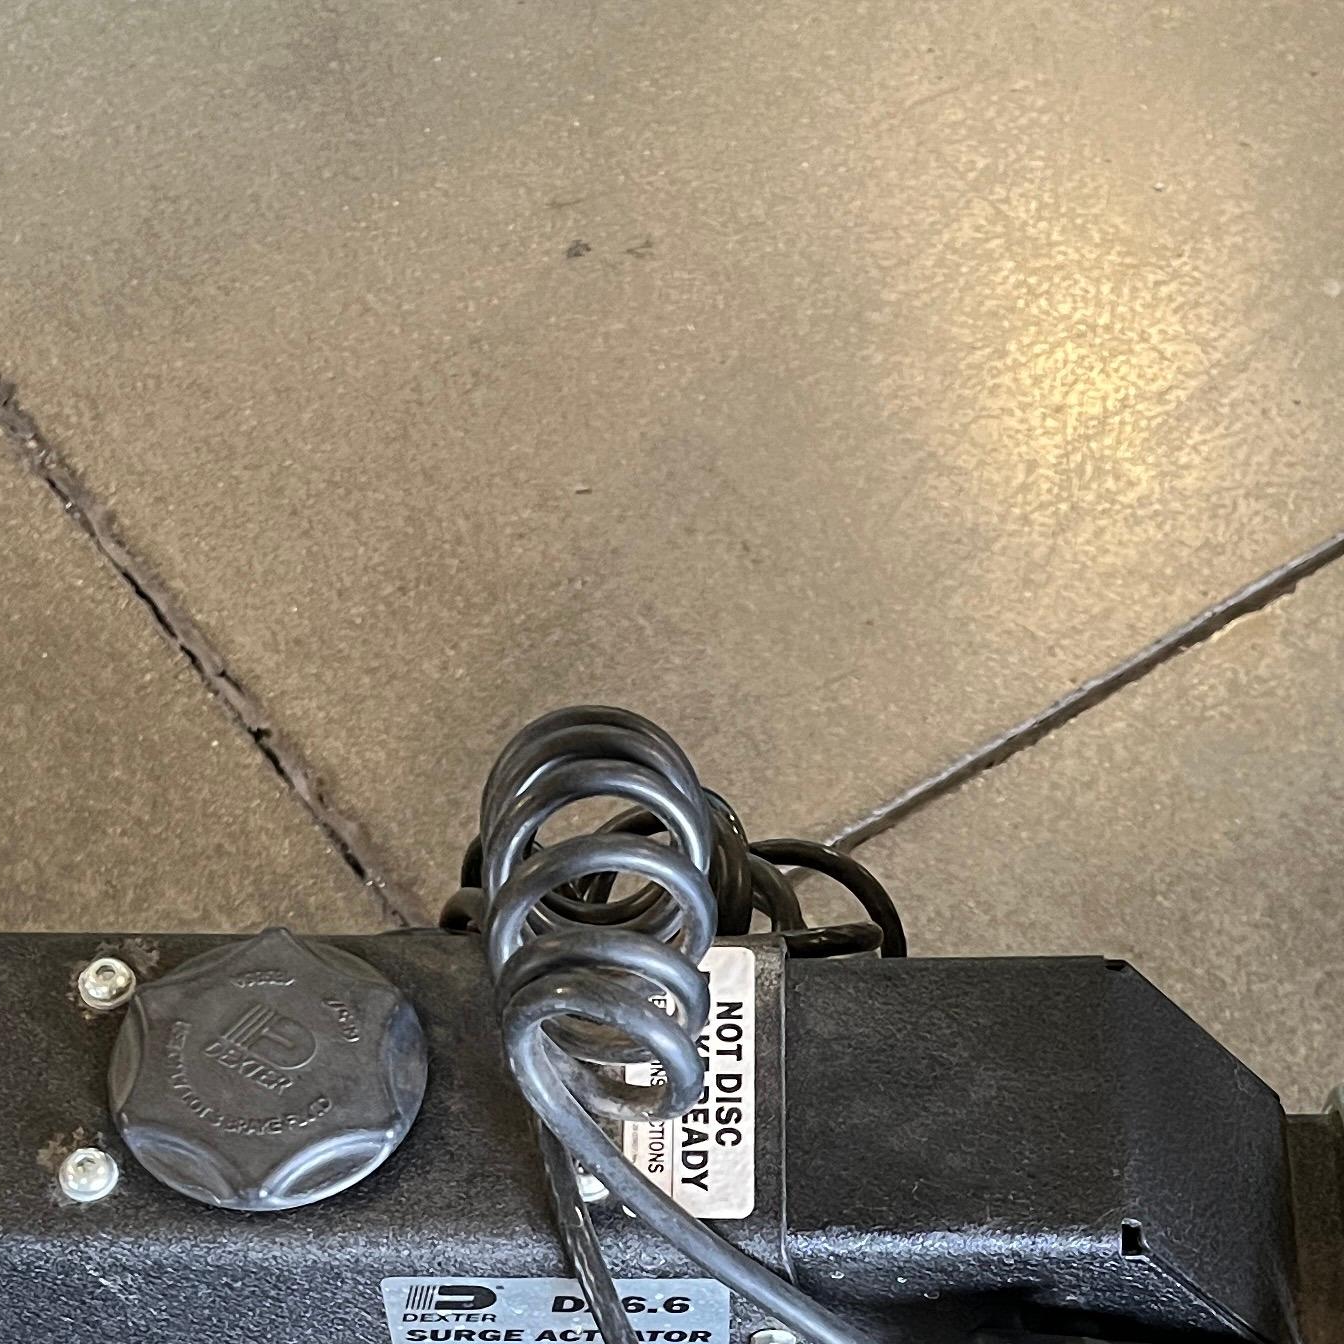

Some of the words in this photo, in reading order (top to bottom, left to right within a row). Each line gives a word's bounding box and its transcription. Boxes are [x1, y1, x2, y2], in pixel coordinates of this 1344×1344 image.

[715, 1001, 743, 1061] NOT
[715, 1073, 743, 1147] DISC
[551, 1295, 691, 1314] D6.6
[402, 1313, 497, 1323] DEXTER
[405, 1329, 525, 1342] SURGE
[534, 1329, 712, 1343] ACTATOR
